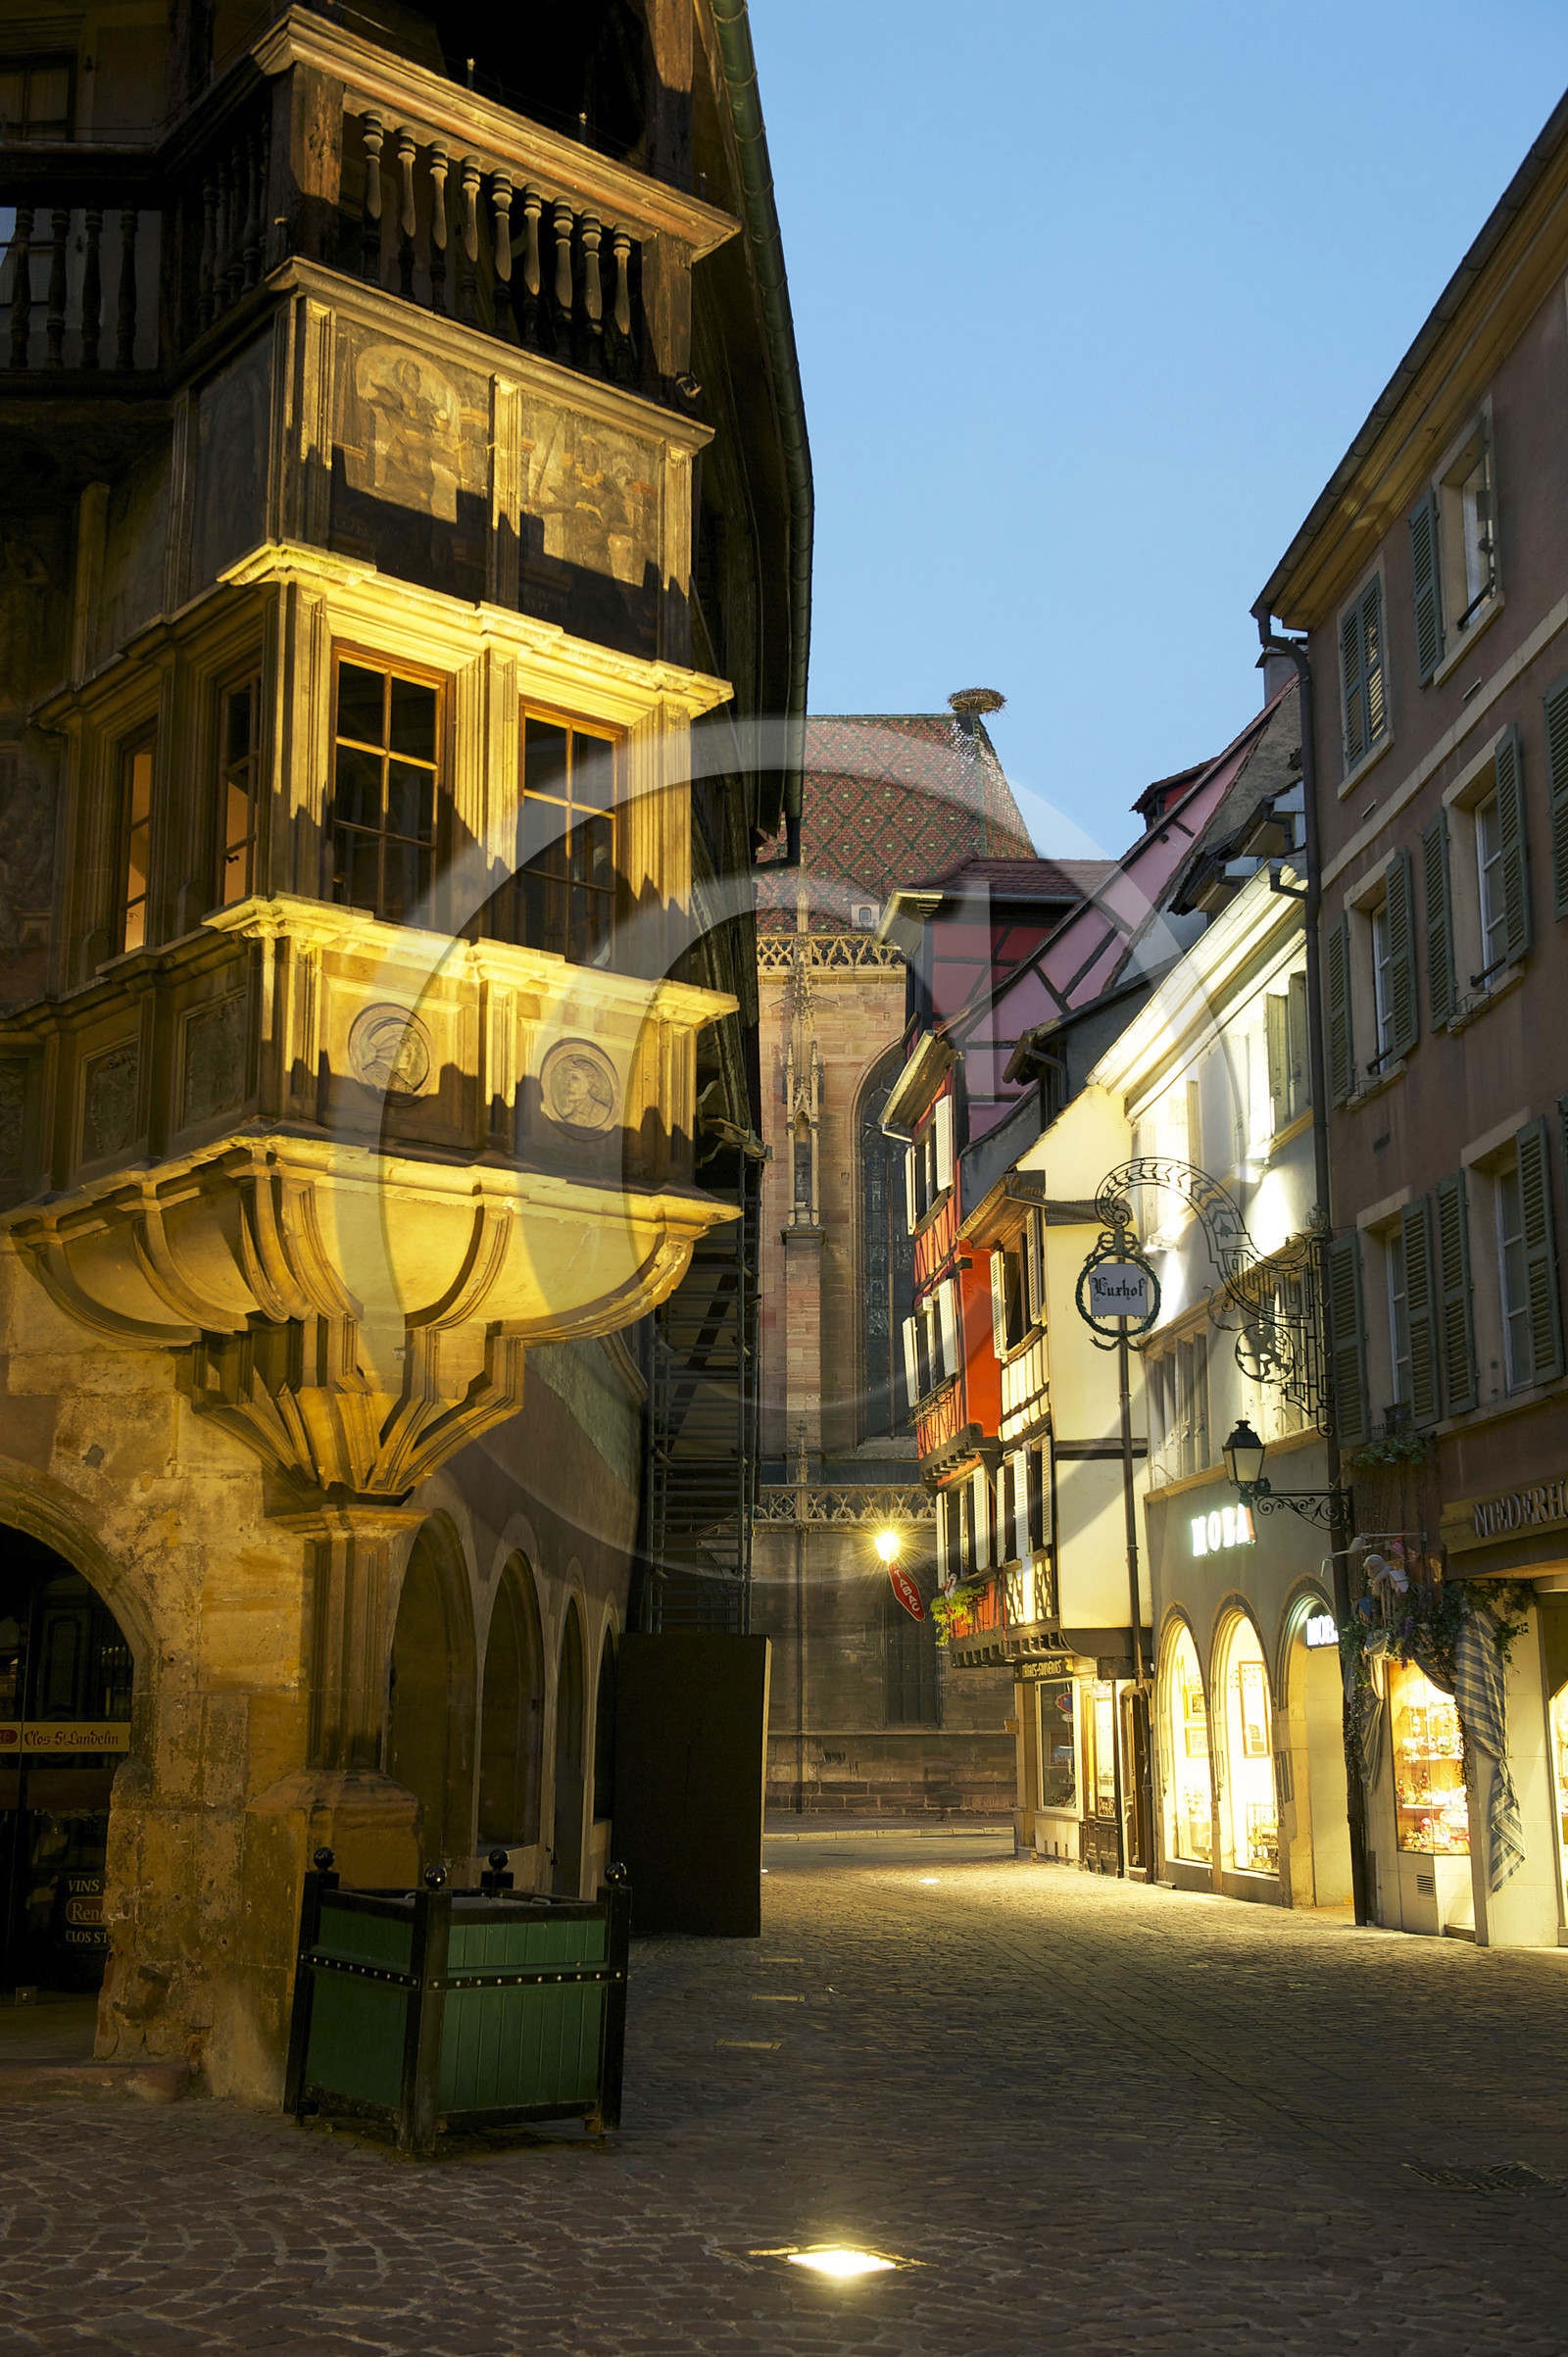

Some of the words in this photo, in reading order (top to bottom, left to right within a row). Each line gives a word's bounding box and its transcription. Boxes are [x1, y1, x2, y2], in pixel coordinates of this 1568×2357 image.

[1473, 1478, 1568, 1538] NIEDERH
[893, 1568, 920, 1612] TABAC
[24, 1730, 51, 1746] Clos
[67, 1730, 119, 1746] Landelin
[68, 1879, 100, 1892] VINS
[72, 1902, 103, 1921] Ren
[65, 1930, 91, 1943] CLOS
